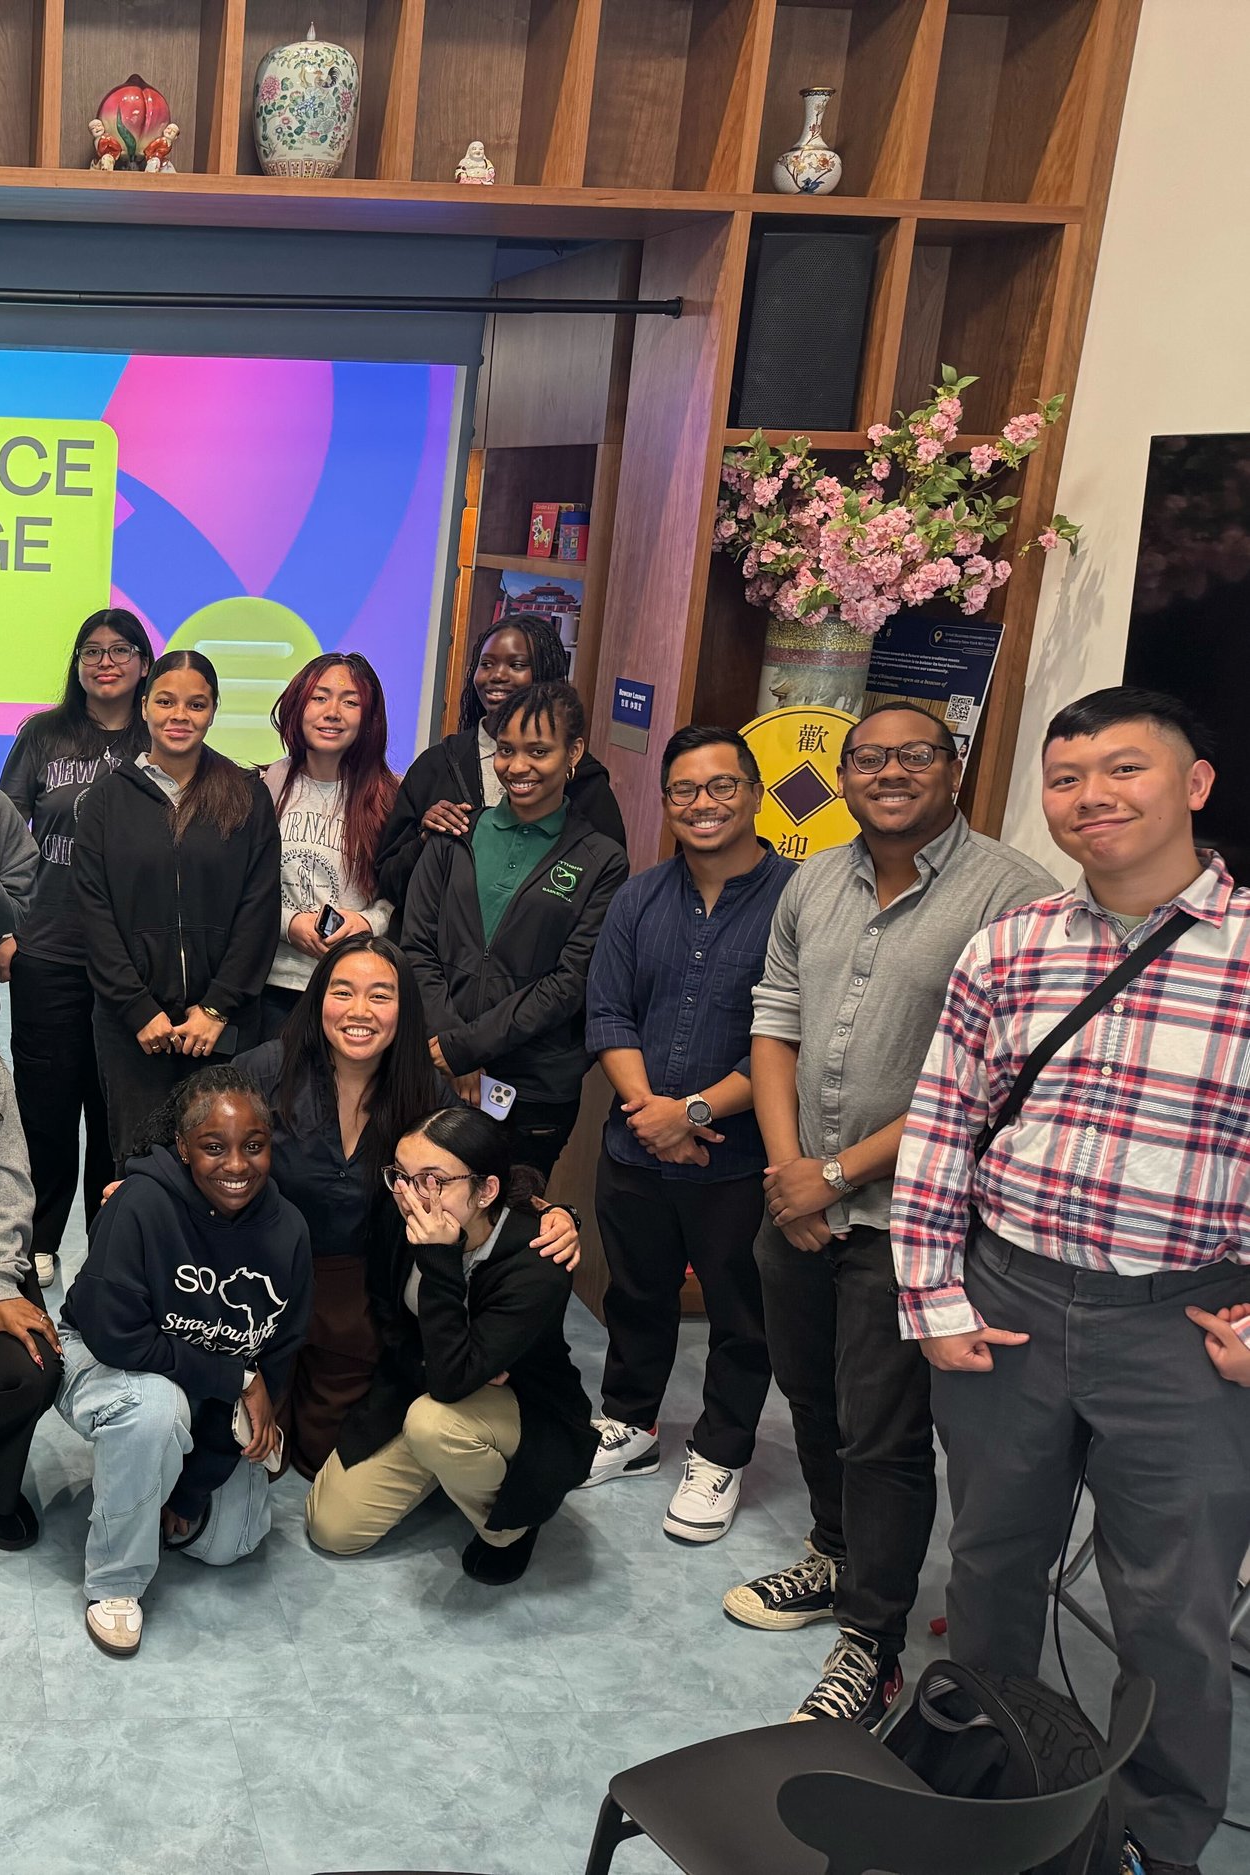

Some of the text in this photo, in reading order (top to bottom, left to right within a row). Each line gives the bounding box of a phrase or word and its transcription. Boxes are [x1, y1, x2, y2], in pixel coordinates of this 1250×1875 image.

[796, 723, 829, 753] 歡
[46, 756, 101, 793] NEW
[777, 832, 808, 858] 迎
[174, 1264, 217, 1295] SO
